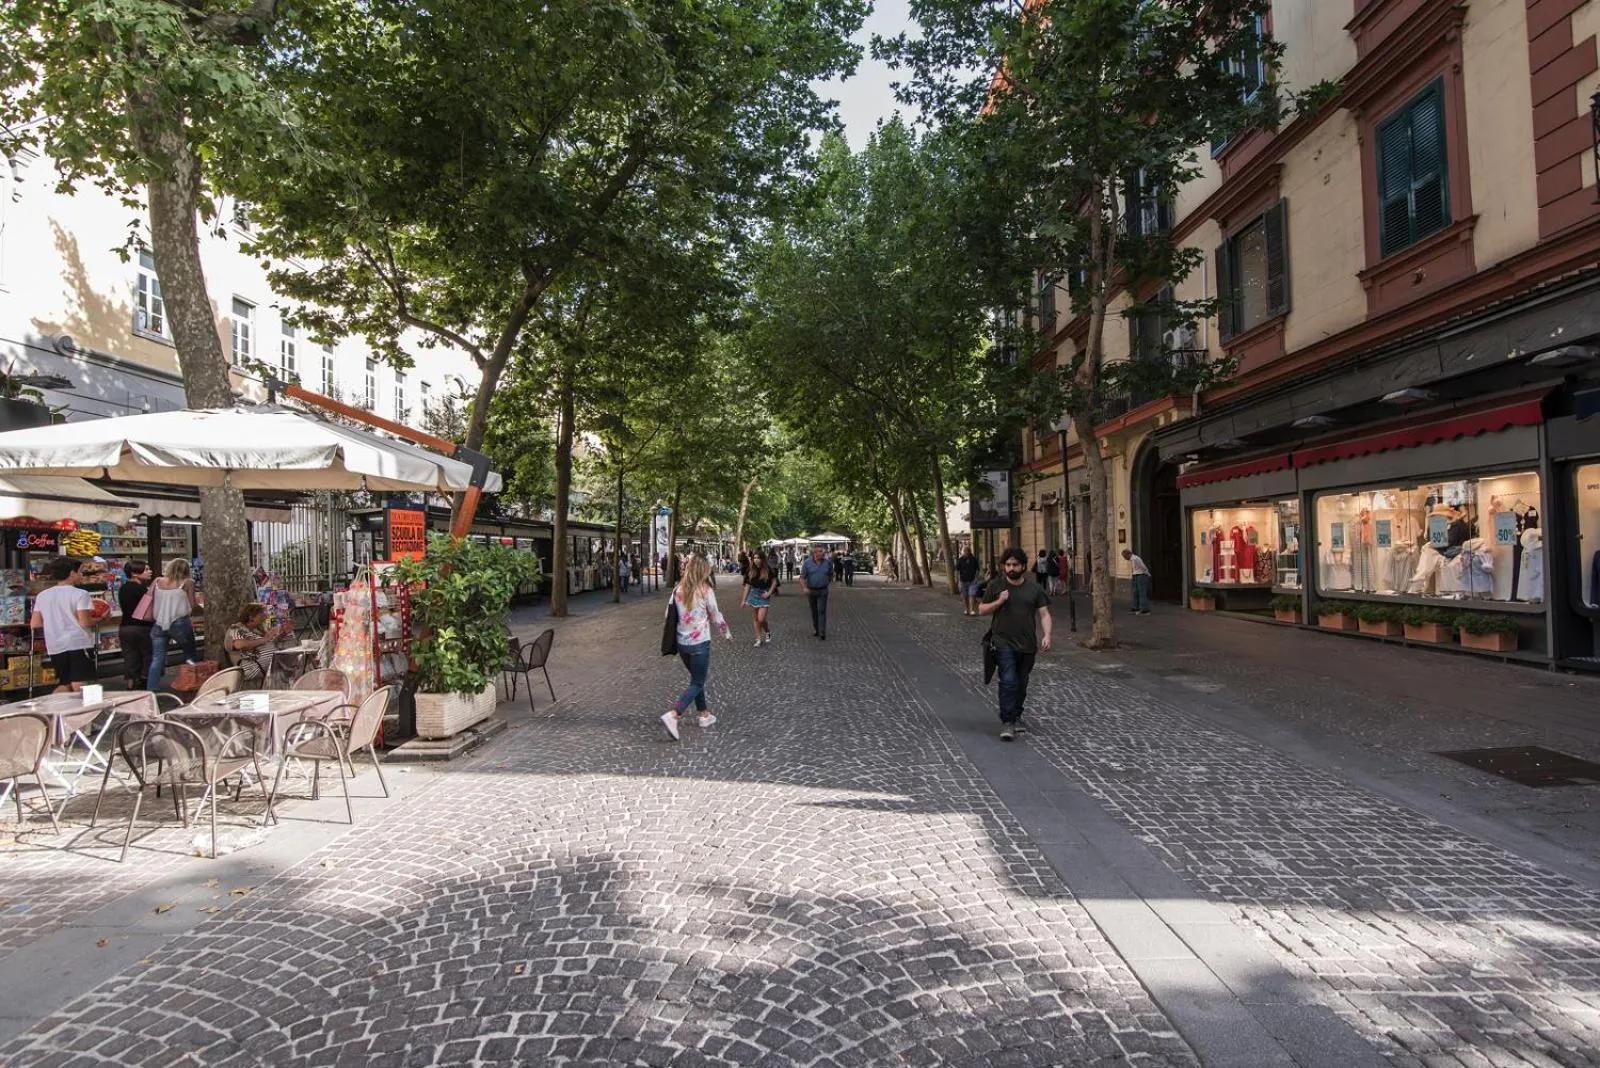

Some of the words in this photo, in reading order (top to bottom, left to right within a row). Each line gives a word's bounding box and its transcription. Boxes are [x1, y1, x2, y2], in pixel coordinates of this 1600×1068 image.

[392, 526, 415, 540] SCUOLA
[417, 527, 424, 540] DI
[28, 533, 56, 548] Coffee
[392, 540, 424, 552] RECITAZIONE
